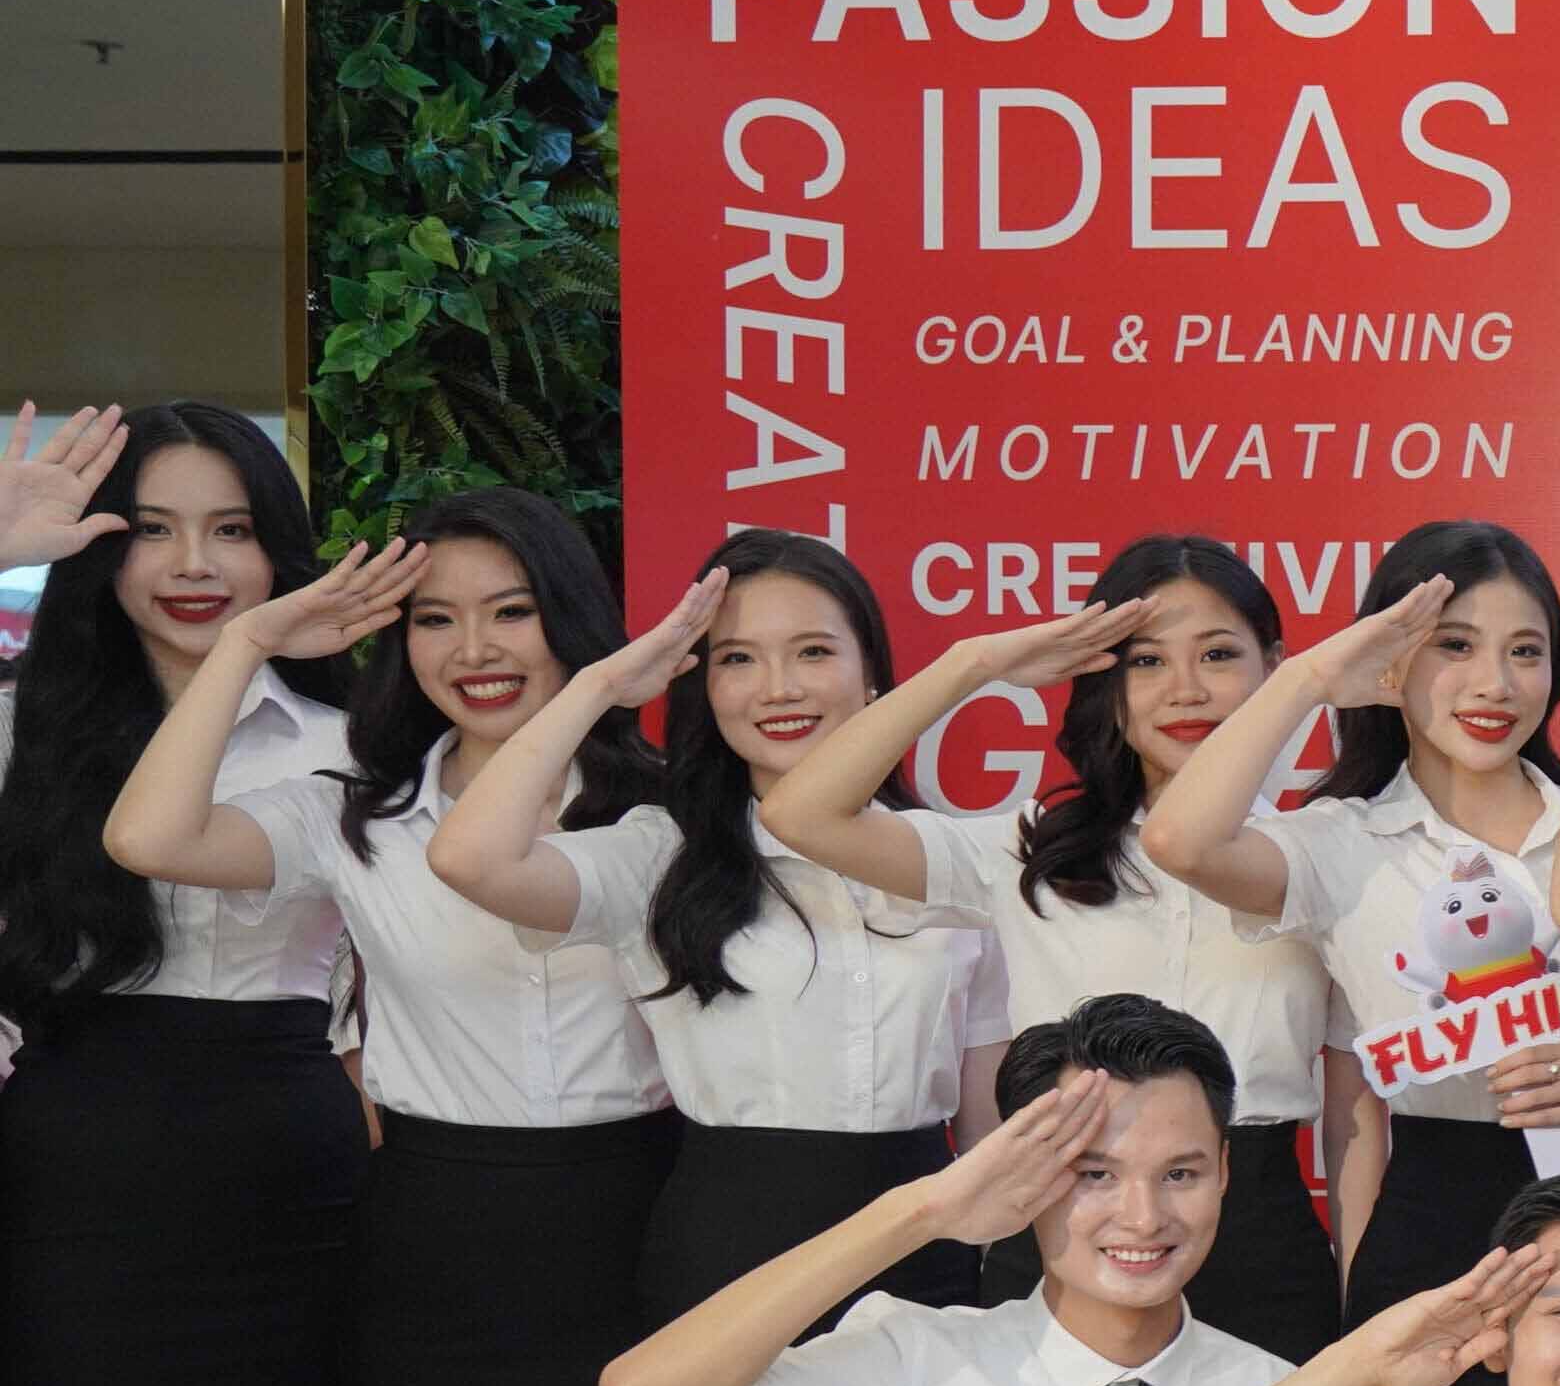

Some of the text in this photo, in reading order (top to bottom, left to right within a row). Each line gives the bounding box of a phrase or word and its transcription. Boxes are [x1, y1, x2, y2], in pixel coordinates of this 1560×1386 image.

[922, 81, 1511, 252] IDEAS
[914, 311, 1514, 365] GOAL & PLANNING
[918, 421, 1514, 481] MOTIVATION
[1366, 1009, 1479, 1088] FLY
